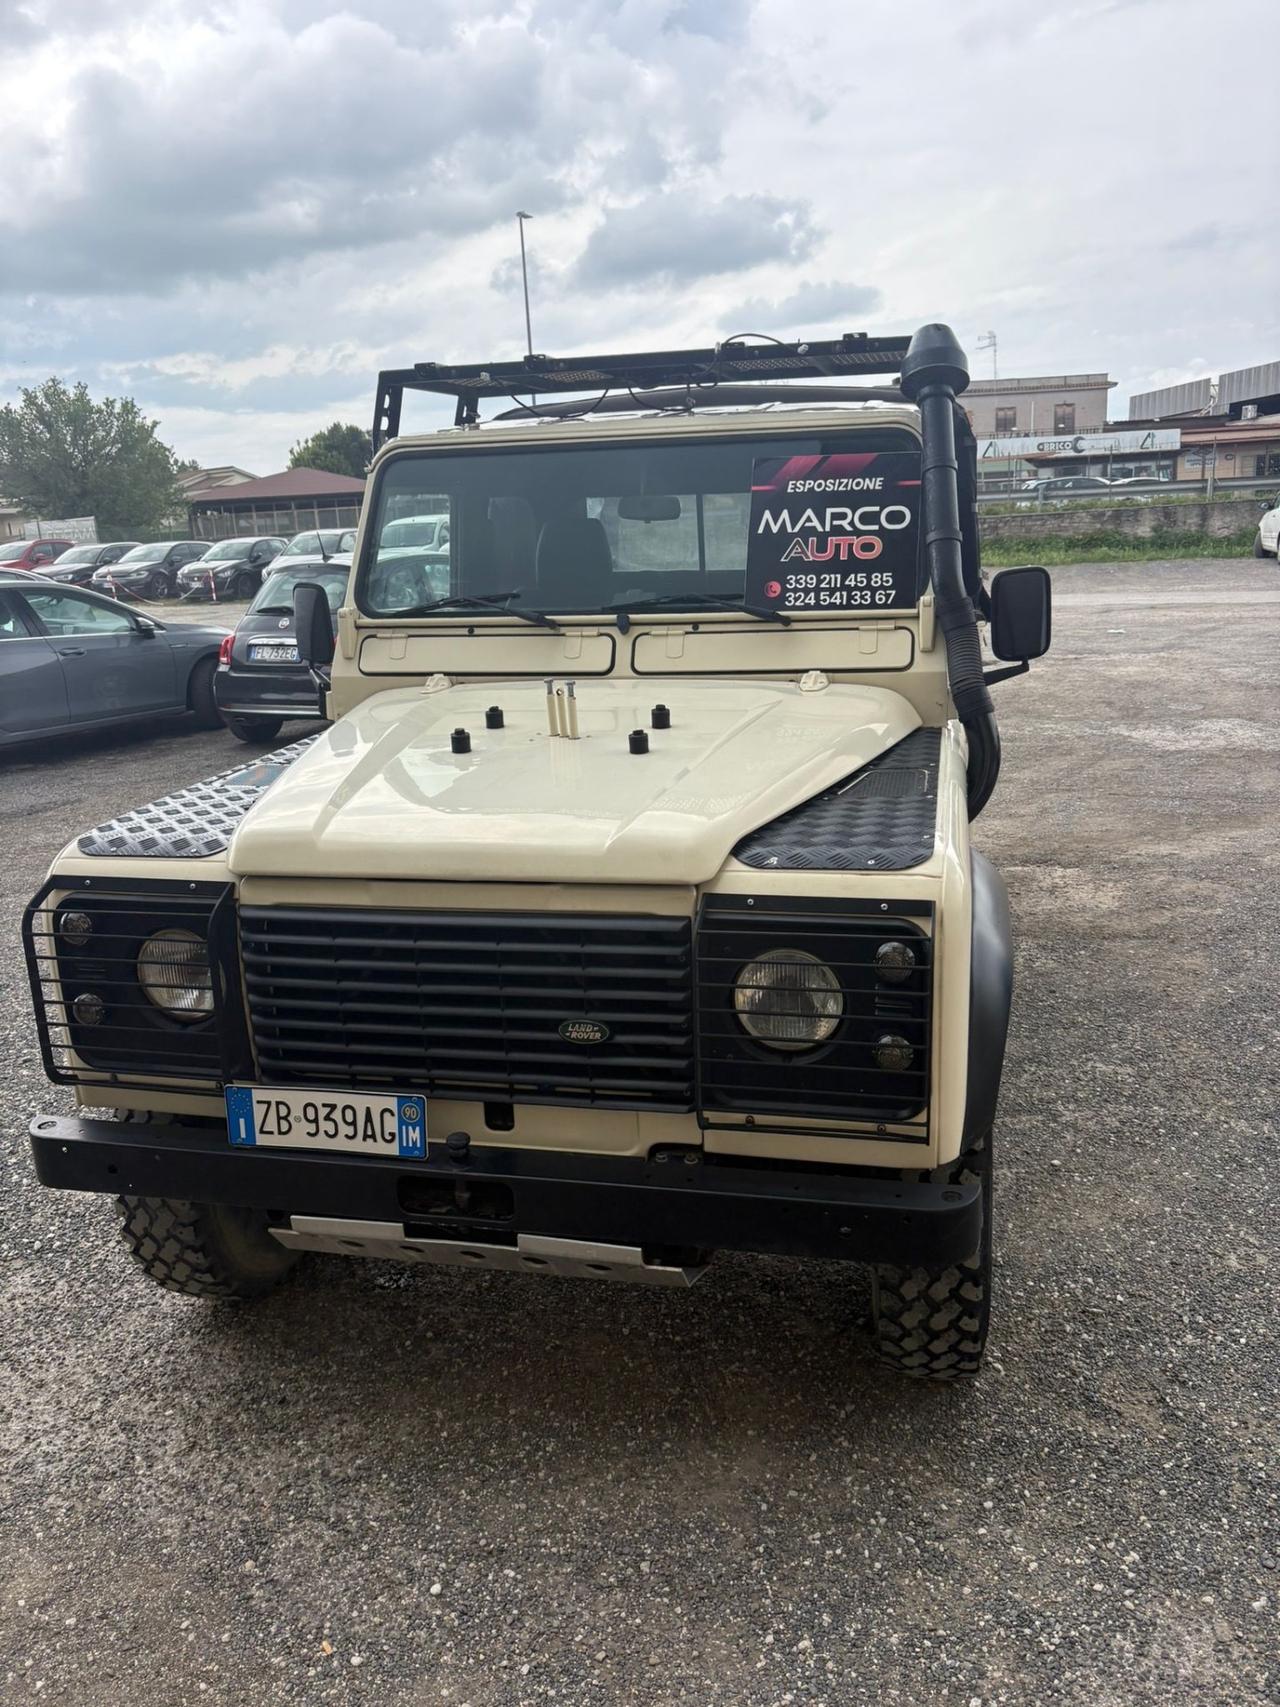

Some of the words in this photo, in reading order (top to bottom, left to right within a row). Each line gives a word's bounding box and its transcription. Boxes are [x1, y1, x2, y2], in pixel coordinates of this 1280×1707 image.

[1043, 442, 1072, 450] BRICO
[787, 477, 885, 493] ESPOSIZIONE
[757, 505, 912, 534] MARCO
[780, 535, 884, 562] AUTO
[785, 574, 817, 589] 339
[820, 573, 842, 588] 211
[844, 573, 867, 588] 45
[870, 572, 893, 587] 85
[785, 592, 816, 606] 324
[819, 591, 847, 606] 541
[850, 591, 872, 605] 33
[875, 590, 896, 605] 67
[568, 1023, 593, 1032] LAND
[570, 1032, 602, 1040] ROVER
[403, 1107, 417, 1120] 90
[401, 1125, 421, 1148] IM
